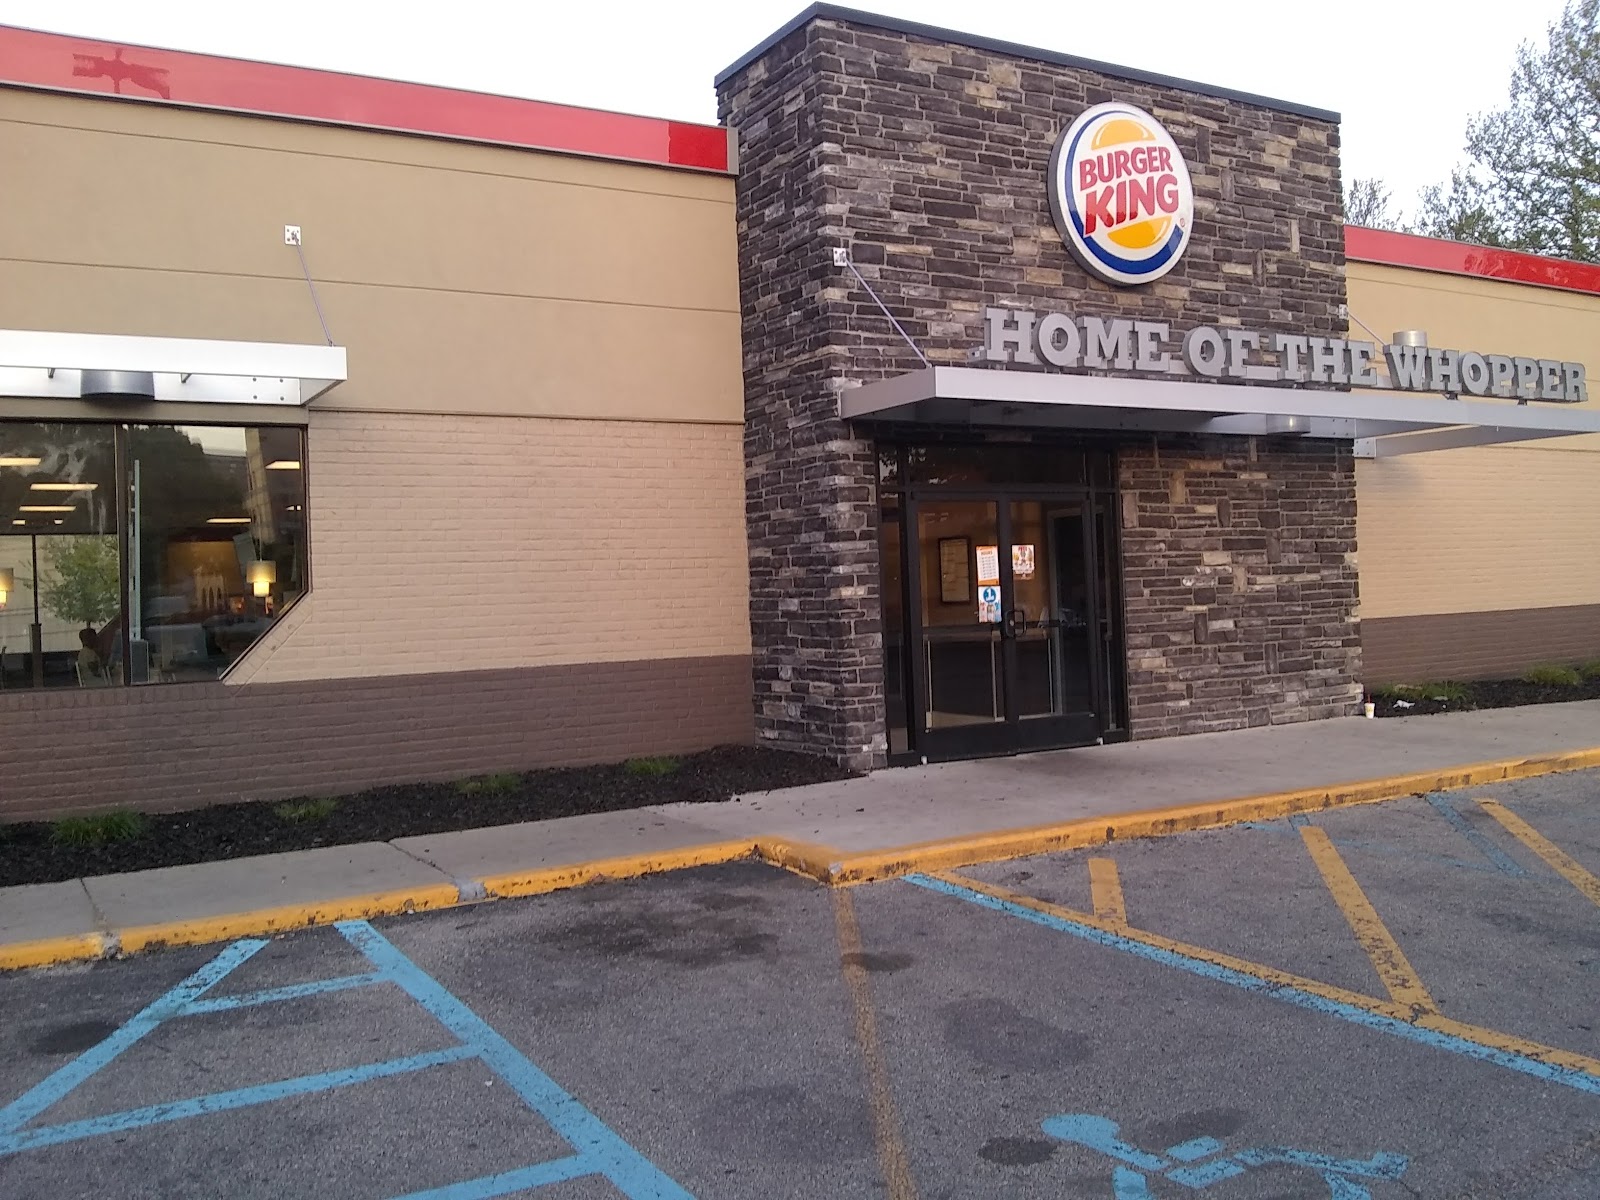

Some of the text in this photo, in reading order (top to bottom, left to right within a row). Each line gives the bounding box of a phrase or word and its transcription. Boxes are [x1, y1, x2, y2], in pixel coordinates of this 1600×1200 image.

[1079, 146, 1173, 191] BURGER
[1084, 174, 1179, 235] KING
[984, 306, 1588, 402] HOME OF THE WHOPPER
